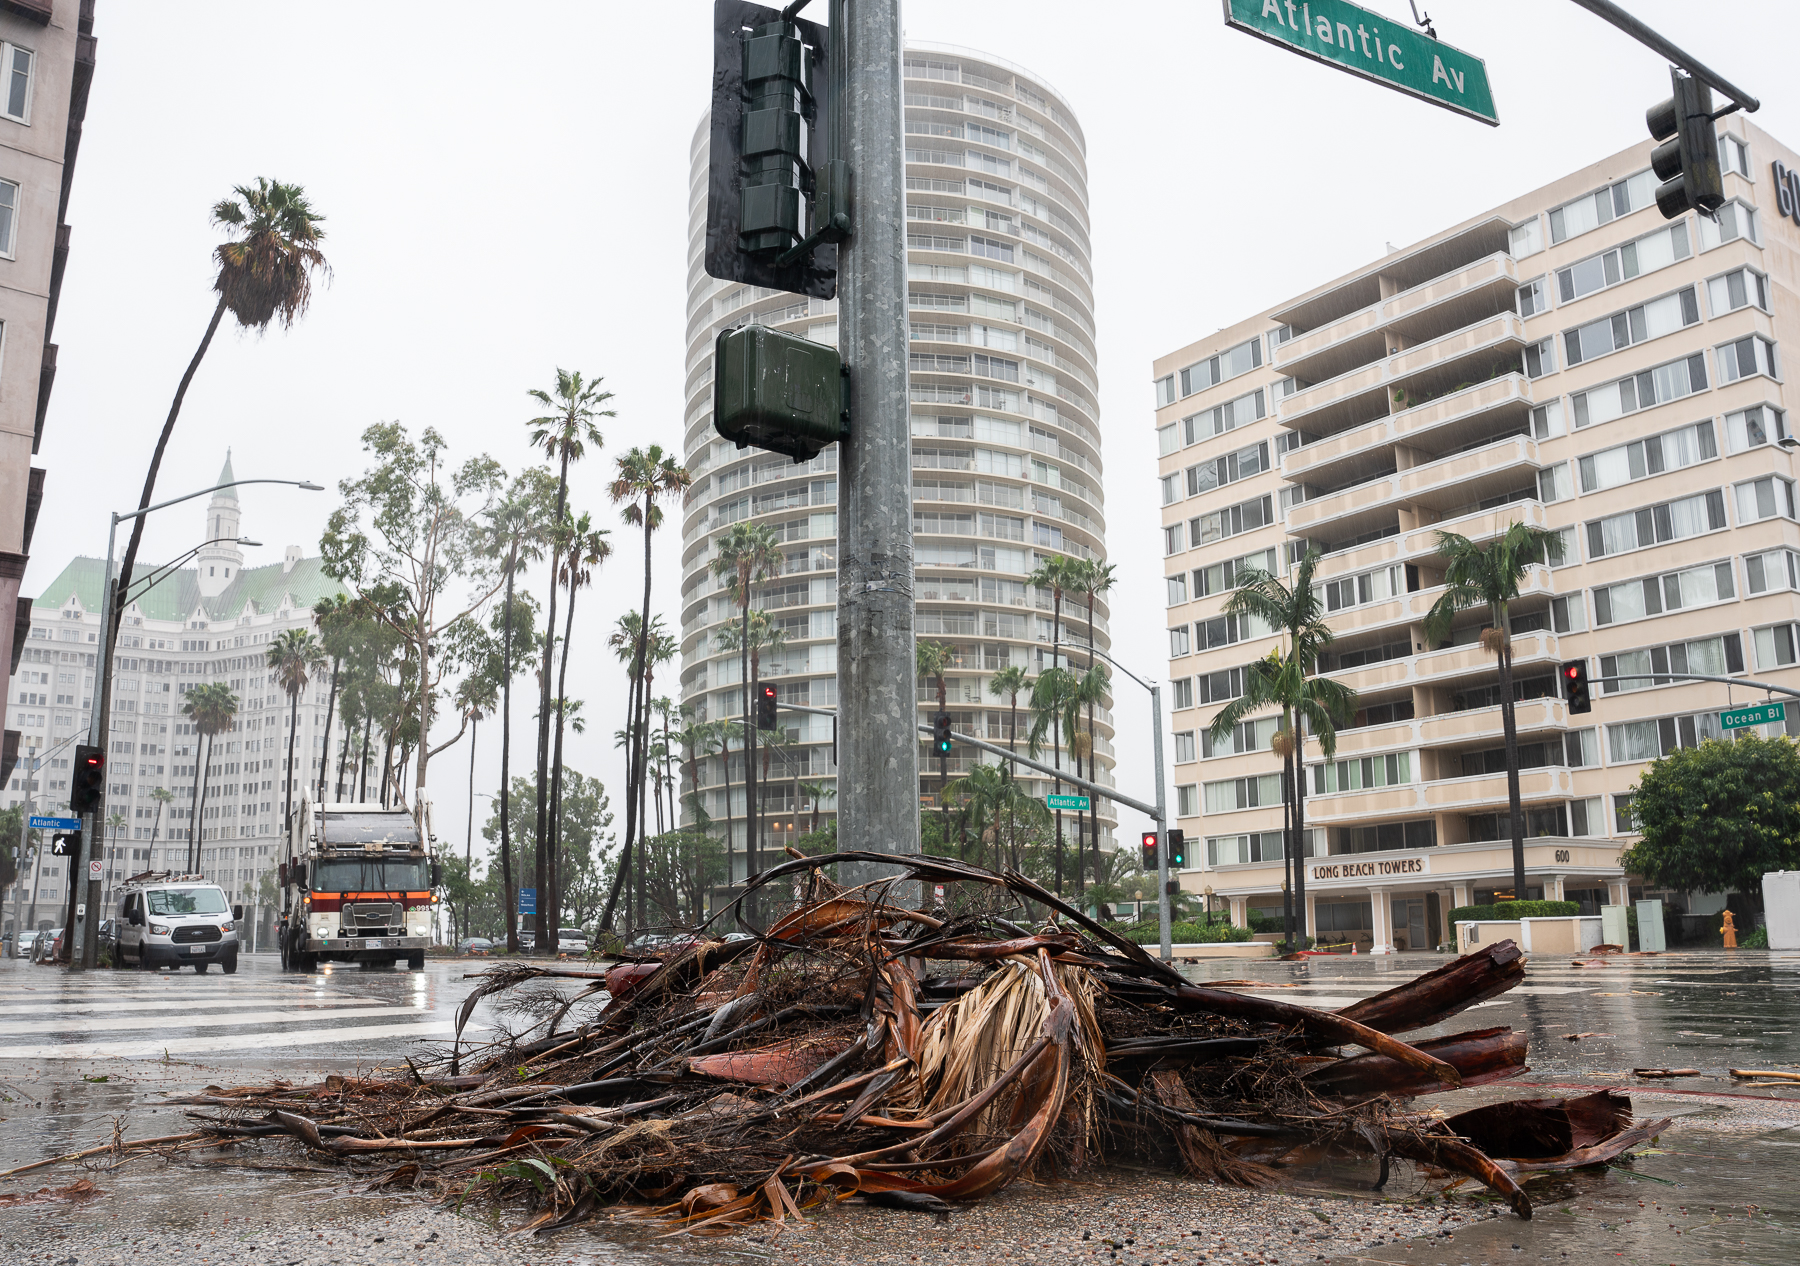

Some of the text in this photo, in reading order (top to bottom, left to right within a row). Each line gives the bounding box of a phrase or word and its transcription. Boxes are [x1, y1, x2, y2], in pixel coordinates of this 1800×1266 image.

[1261, 0, 1465, 94] Atlantic Av
[1725, 707, 1780, 725] Ocean Bl
[1050, 797, 1087, 807] Atlantic Av
[32, 818, 60, 827] Atlantic
[1555, 849, 1570, 863] 600
[1314, 859, 1422, 880] LONG BEACH TOWERS
